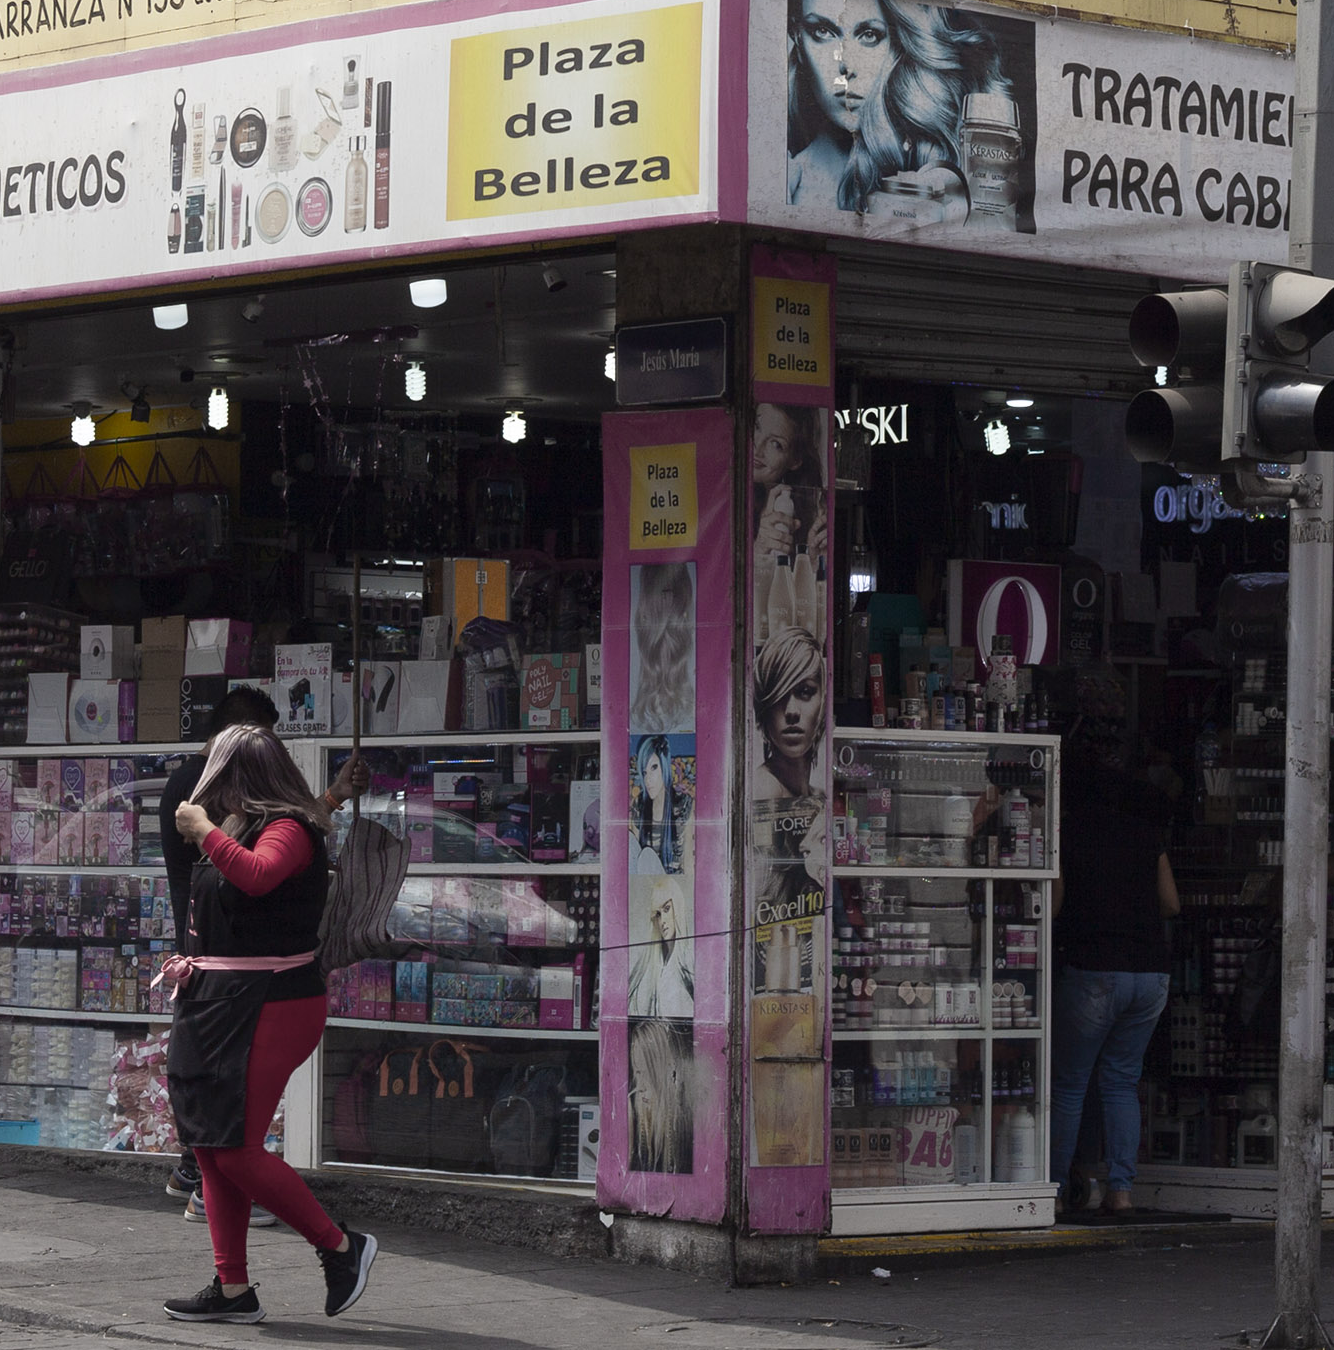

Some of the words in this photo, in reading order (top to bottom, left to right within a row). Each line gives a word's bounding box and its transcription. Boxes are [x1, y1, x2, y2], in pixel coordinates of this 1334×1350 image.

[503, 38, 646, 81] Plaza
[1062, 62, 1294, 148] TRATAMIE
[505, 102, 572, 140] de
[593, 93, 639, 129] la
[474, 154, 671, 202] Belleza
[1062, 149, 1184, 217] PARA
[1196, 167, 1289, 231] CAB
[775, 296, 811, 317] Plaza
[777, 325, 795, 342] de
[798, 326, 809, 343] la
[640, 349, 667, 372] Jesús
[669, 346, 700, 369] María
[768, 354, 817, 373] Belleza
[647, 464, 679, 481] Plaza
[650, 491, 664, 508] de
[668, 490, 679, 507] la
[643, 520, 687, 537] Belleza
[1070, 639, 1092, 650] GEL
[277, 657, 286, 665] En
[287, 657, 293, 665] la
[300, 667, 308, 675] de
[309, 667, 317, 675] tu
[530, 665, 546, 679] POLY
[528, 675, 552, 694] NAIL
[532, 690, 547, 704] GEL
[181, 679, 191, 738] TOKYO
